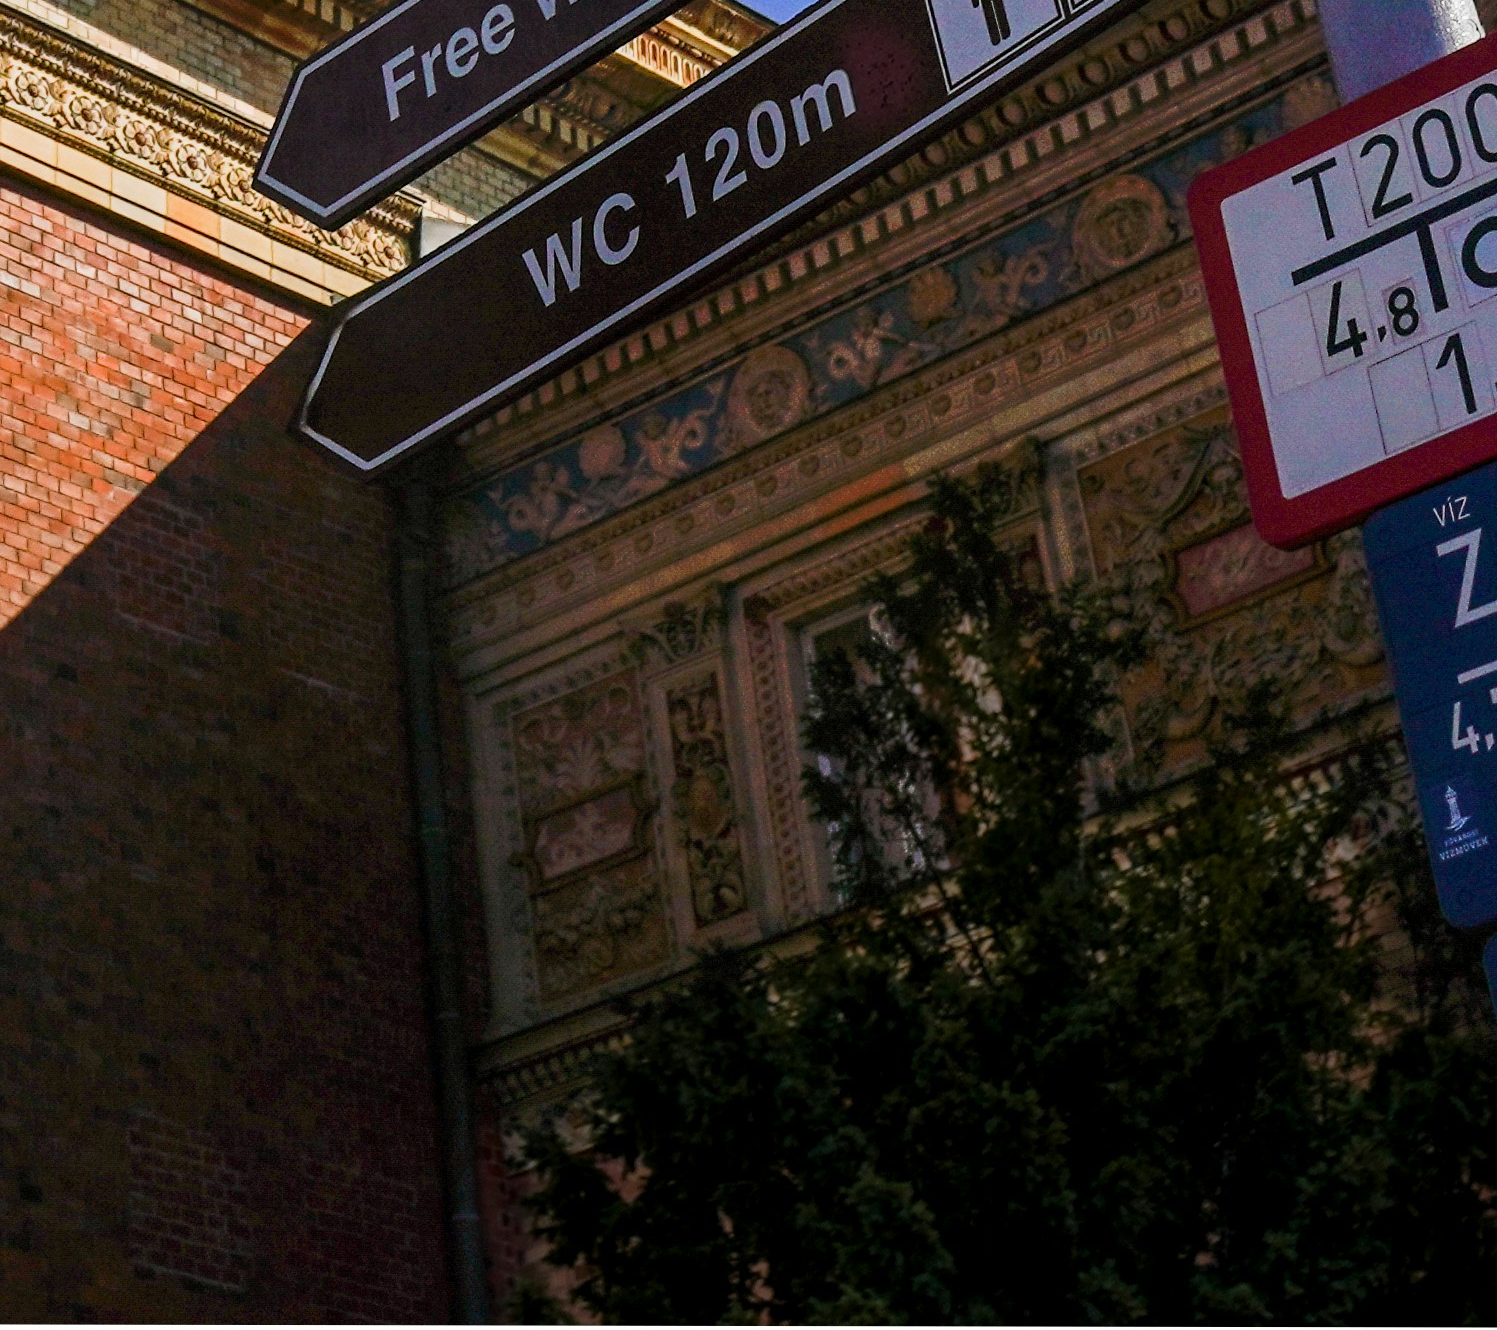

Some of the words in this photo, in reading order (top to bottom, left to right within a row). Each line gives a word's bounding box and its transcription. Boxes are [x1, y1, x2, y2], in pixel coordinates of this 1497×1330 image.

[380, 2, 517, 122] Free
[521, 191, 641, 308] WC
[666, 69, 856, 219] 120m
[1326, 280, 1420, 358] 4,8
[1433, 496, 1471, 527] VÍZ
